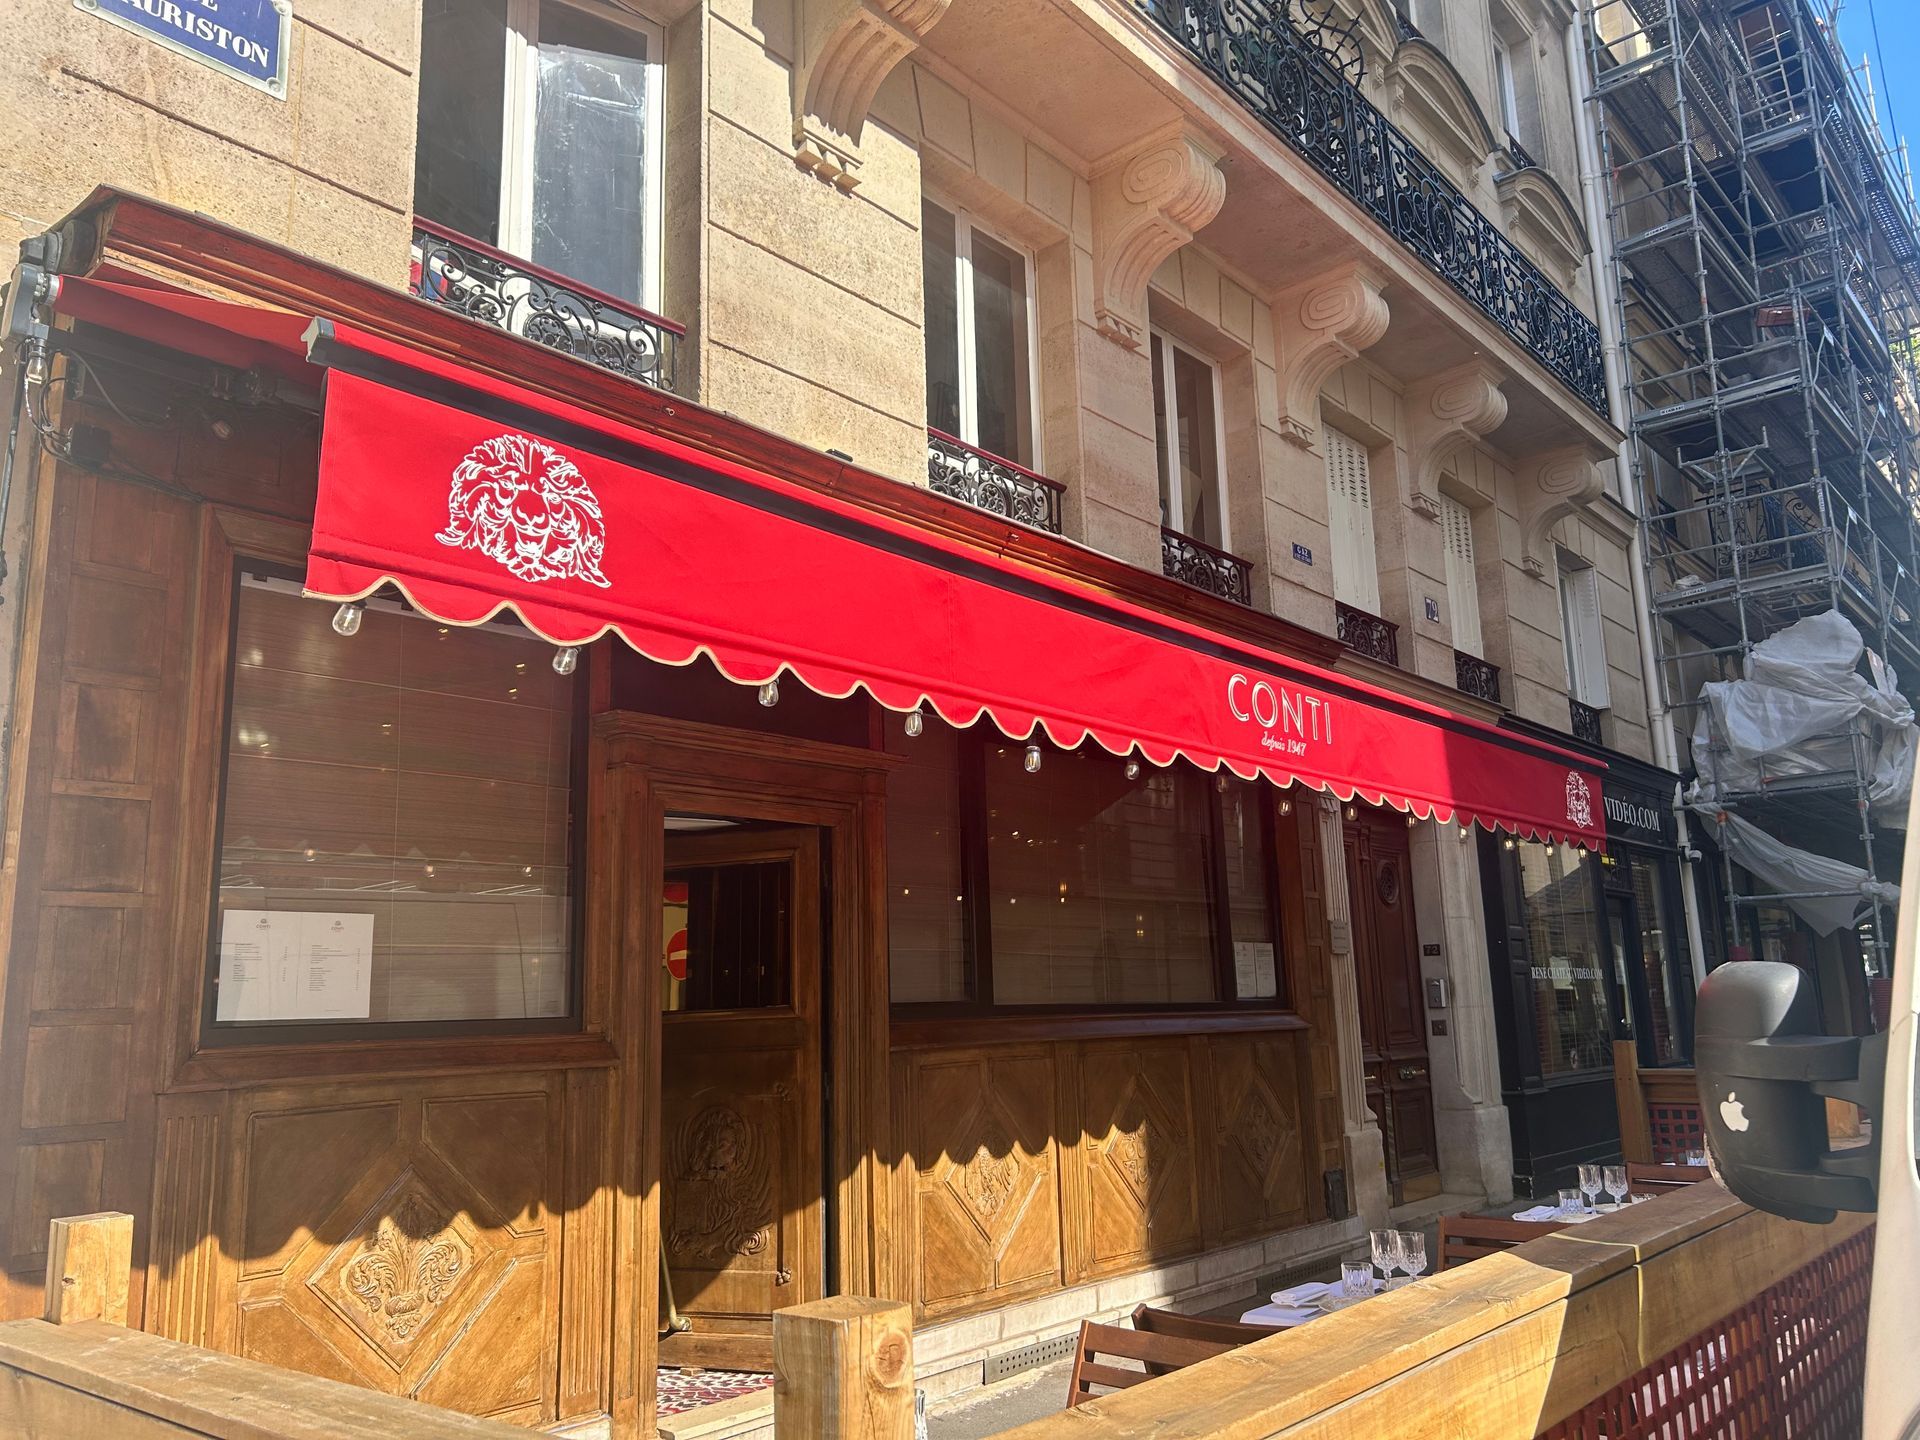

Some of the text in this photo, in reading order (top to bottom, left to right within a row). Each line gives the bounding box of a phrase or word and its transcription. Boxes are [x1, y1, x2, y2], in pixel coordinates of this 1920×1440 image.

[1228, 673, 1331, 744] CONTI
[1261, 731, 1306, 756] depuis 1947
[1603, 795, 1660, 831] VIDÉO.COM
[1531, 964, 1547, 979] RENÉ
